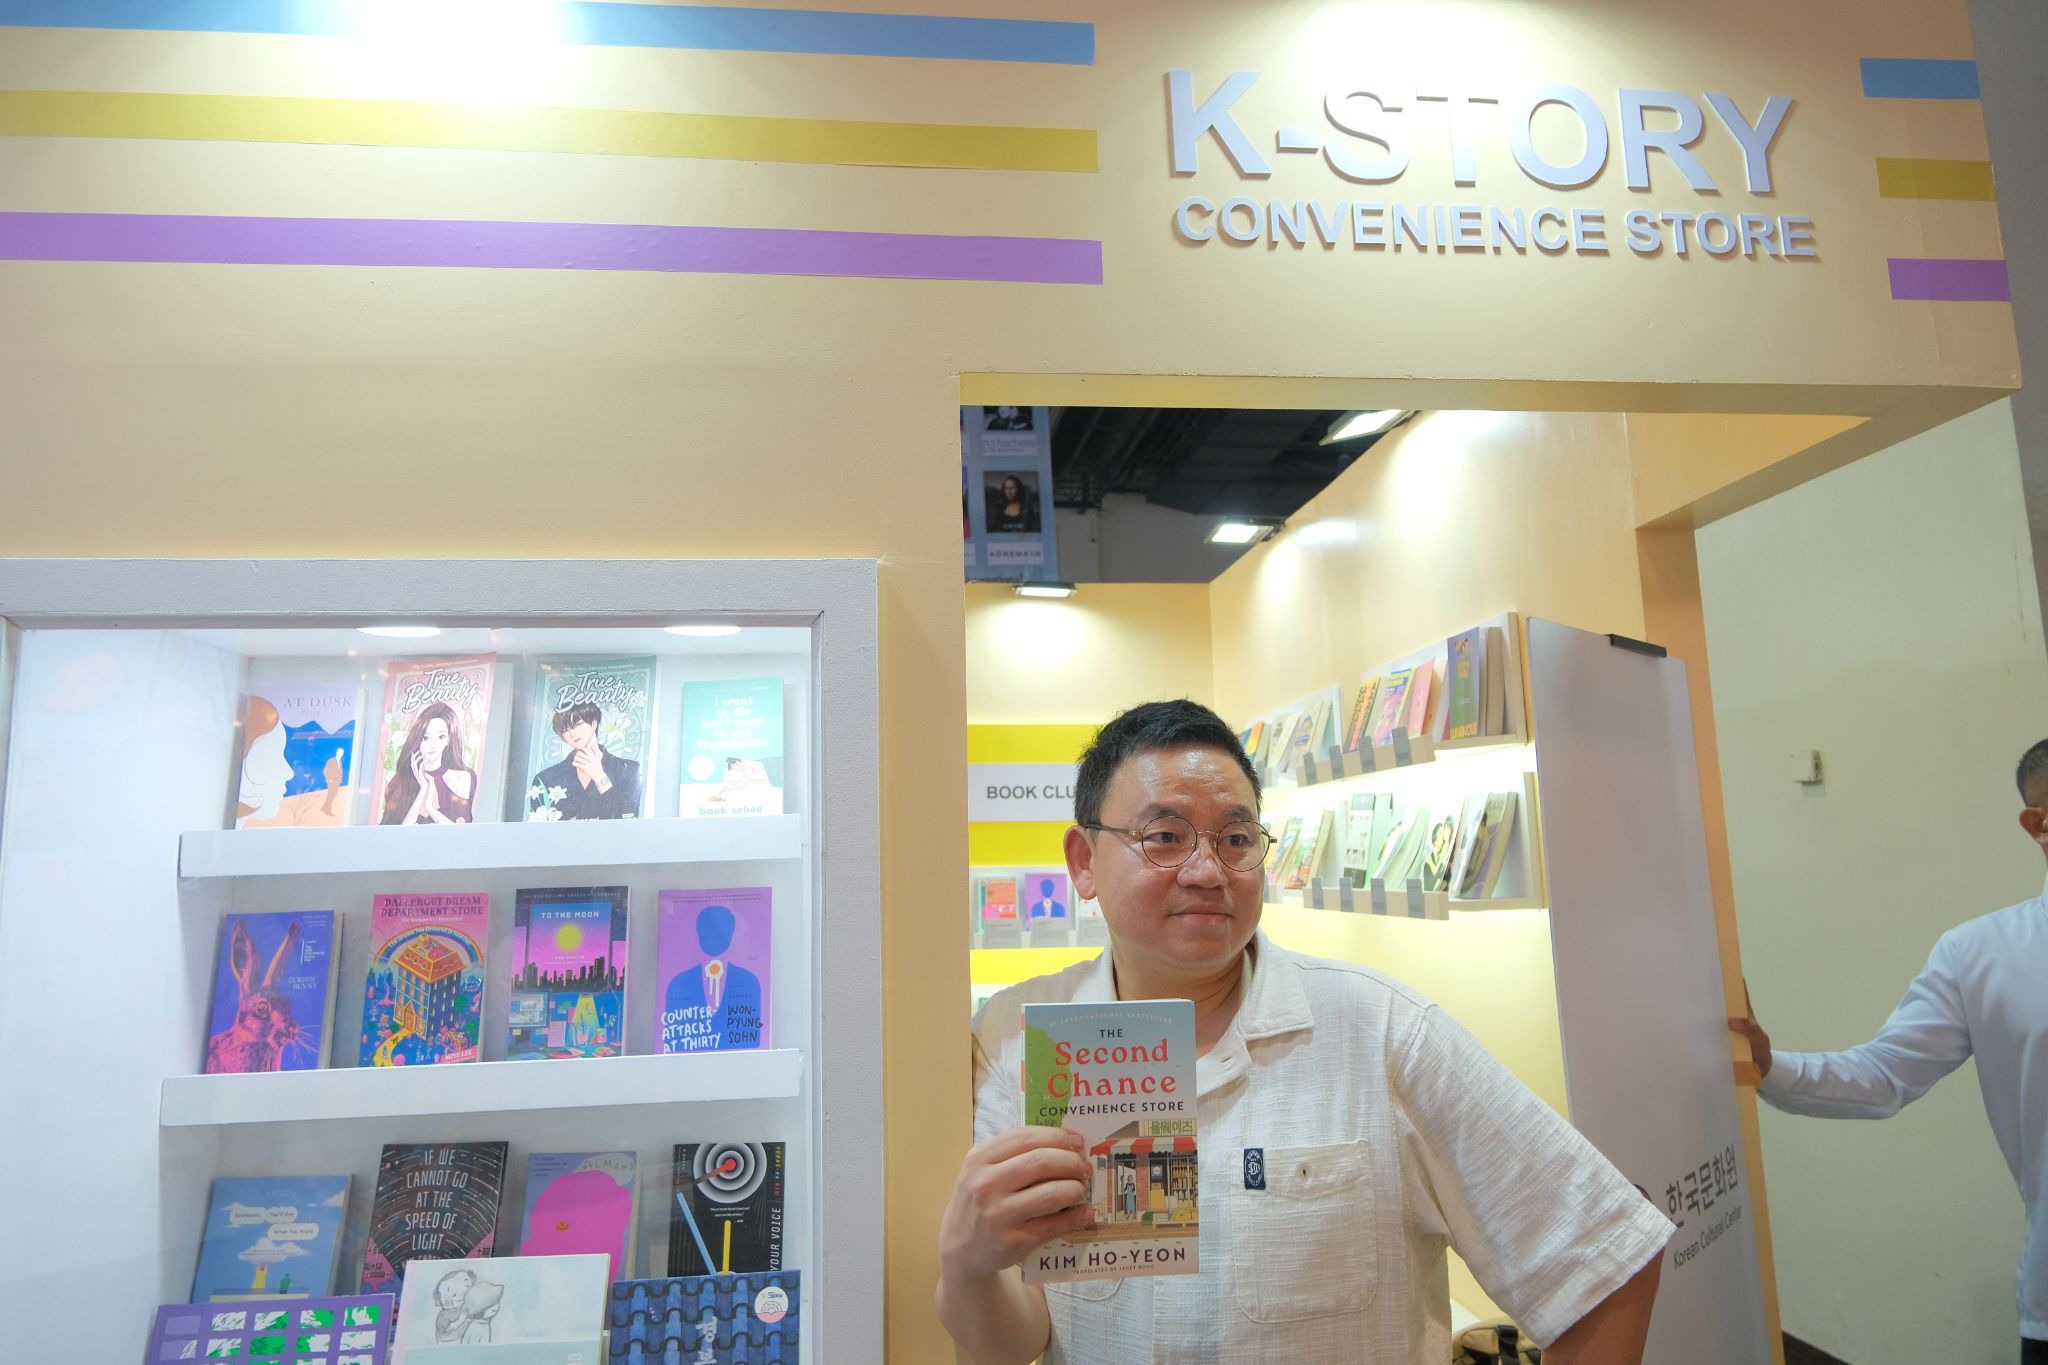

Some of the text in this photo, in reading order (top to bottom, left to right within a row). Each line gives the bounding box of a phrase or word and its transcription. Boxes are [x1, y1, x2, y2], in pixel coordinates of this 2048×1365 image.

[1168, 68, 1795, 193] K-STORY
[1176, 196, 1817, 257] CONVENIENCE STORE
[424, 668, 460, 690] True
[575, 671, 614, 692] True
[283, 696, 352, 708] AT DUSK
[402, 676, 479, 713] Beauty
[555, 679, 636, 713] Beauty
[986, 784, 1076, 799] BOOK CLU
[699, 806, 729, 816] baek
[450, 906, 484, 915] STORE
[661, 1005, 717, 1025] COUNTER-
[727, 1005, 756, 1016] WON-
[662, 1019, 712, 1041] ATTACKS
[726, 1017, 763, 1029] PYUNG
[1099, 1028, 1123, 1038] THE
[663, 1032, 721, 1055] AT THIRTY
[728, 1030, 759, 1044] SOHN
[1055, 1039, 1169, 1067] Second
[1047, 1072, 1177, 1098] Chance
[1039, 1101, 1184, 1117] CONVENIENCE STORE
[424, 1149, 457, 1166] IF WE
[406, 1169, 469, 1189] CANNOT GO
[1665, 1143, 1739, 1229] 한국문화원
[415, 1190, 454, 1208] AT THE
[405, 1212, 458, 1231] SPEED OF
[411, 1233, 445, 1251] LIGHT
[769, 1207, 782, 1271] YOUR VOICE
[1673, 1204, 1743, 1270] Korean Cultural Center
[1040, 1247, 1186, 1271] KIM HO-YEON
